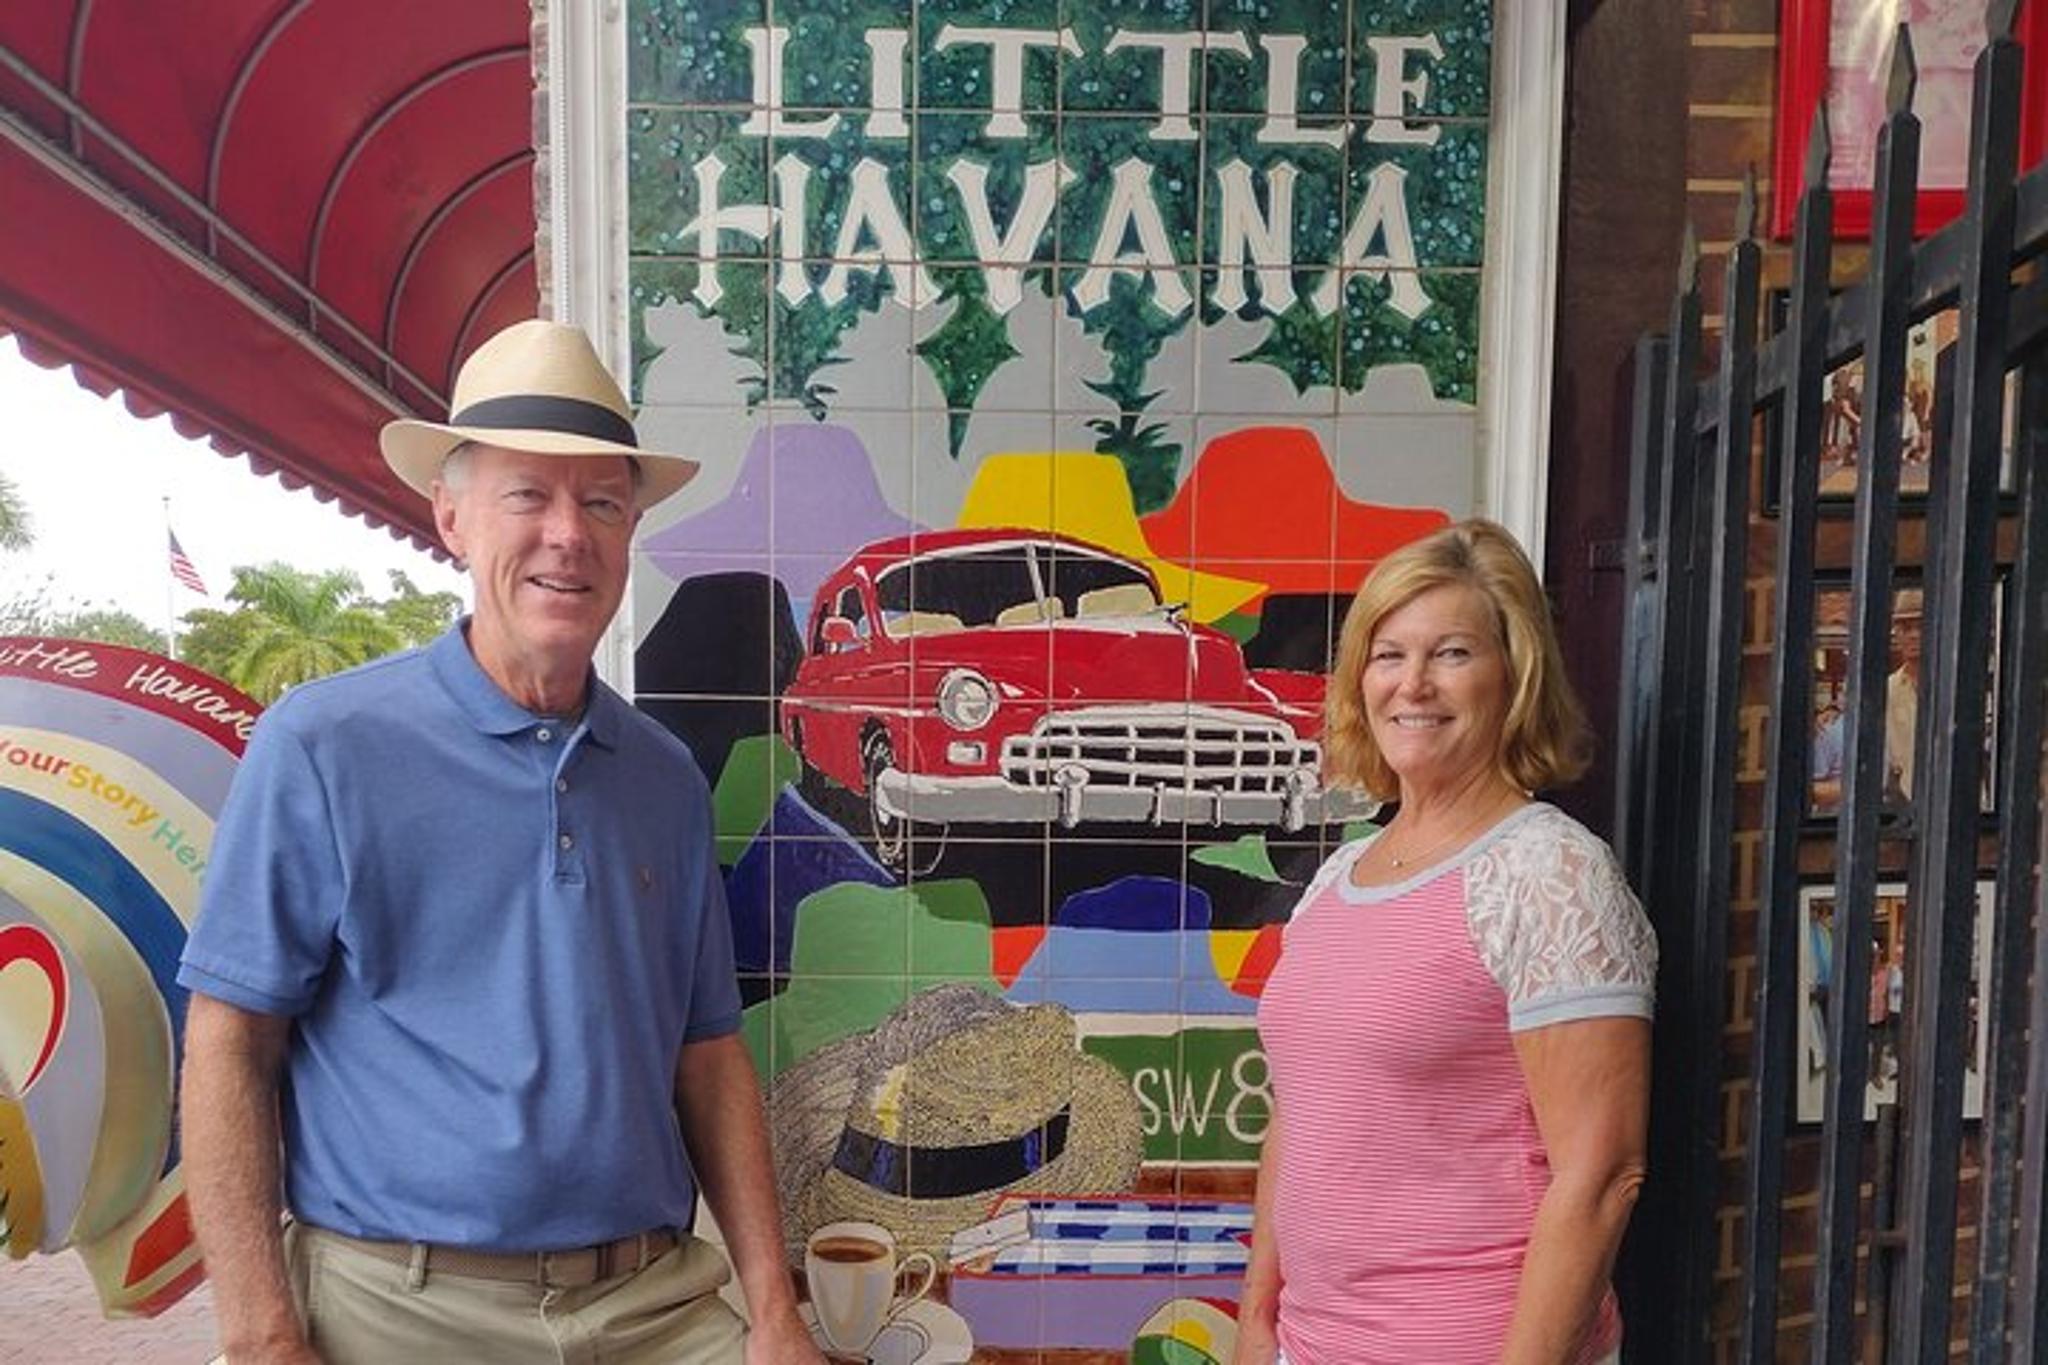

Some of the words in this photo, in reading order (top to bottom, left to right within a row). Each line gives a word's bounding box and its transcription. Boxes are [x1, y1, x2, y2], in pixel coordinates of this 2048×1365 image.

[740, 24, 1446, 148] LITTLE
[677, 153, 1433, 320] HAVANA
[0, 642, 98, 678] ittle
[150, 819, 206, 874] Her
